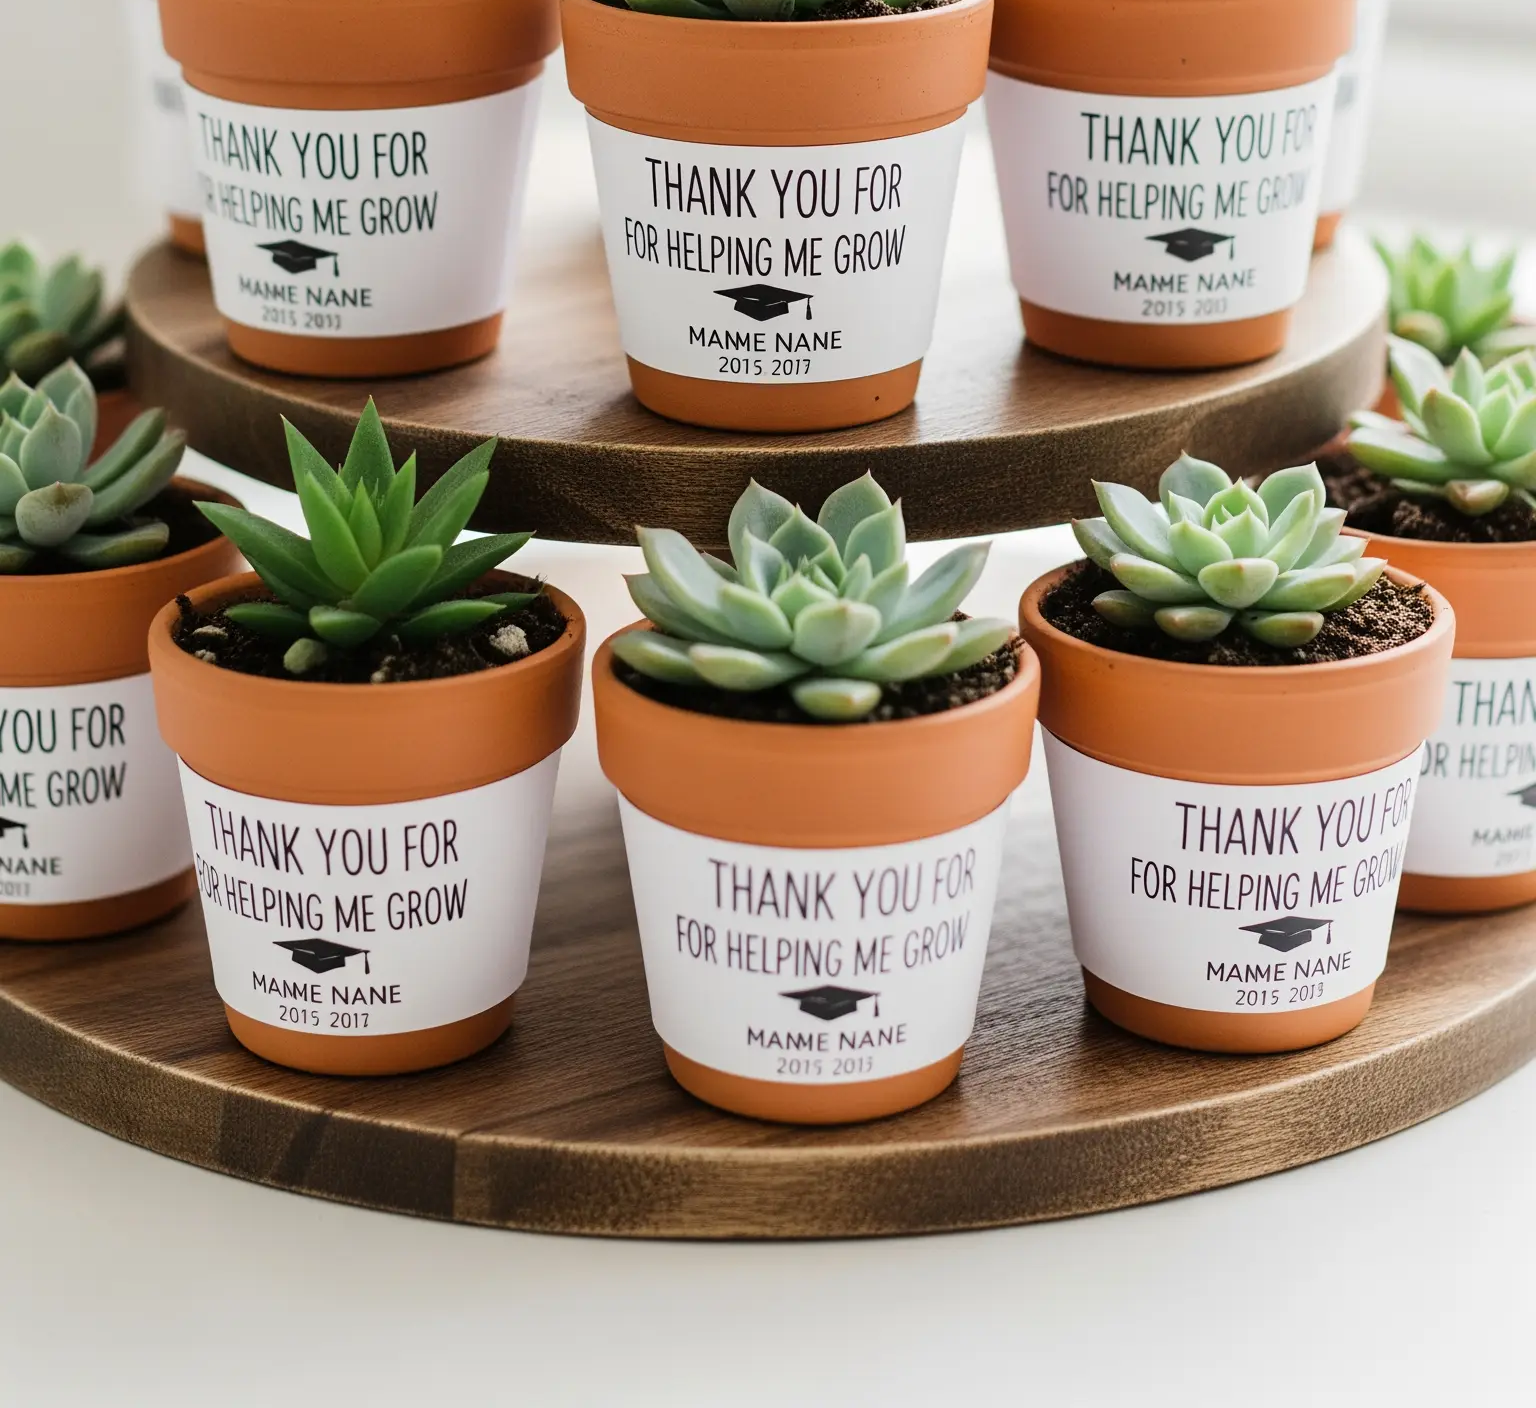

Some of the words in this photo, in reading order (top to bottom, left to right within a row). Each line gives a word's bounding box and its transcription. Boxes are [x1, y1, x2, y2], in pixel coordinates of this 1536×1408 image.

[199, 112, 281, 176] THANK
[291, 131, 359, 180] YOU
[374, 131, 428, 179] FOR
[1080, 112, 1200, 166] THANK
[1215, 112, 1275, 165] YOU
[218, 181, 303, 233] HELPING
[313, 198, 350, 235] ME
[361, 191, 438, 235] GROW
[645, 157, 757, 218] THANK
[770, 168, 841, 219] YOU
[853, 163, 902, 215] FOR
[1047, 171, 1089, 215] FOR
[1098, 180, 1204, 220] HELPING
[1214, 180, 1249, 220] ME
[624, 216, 659, 265] FOR
[667, 229, 772, 276] HELPING
[784, 237, 822, 277] ME
[834, 224, 907, 275] GROW
[306, 286, 373, 307] NANE
[1197, 269, 1256, 293] NANE
[1142, 300, 1185, 317] 2015
[719, 356, 762, 375] 2015
[775, 330, 842, 353] NANE
[71, 703, 126, 751] FOR
[47, 762, 126, 807] GROW
[204, 800, 304, 875] THANK
[315, 828, 387, 876] YOU
[404, 820, 458, 871] FOR
[1175, 801, 1302, 855] THANK
[1316, 793, 1376, 851] YOU
[1380, 778, 1411, 834] FOR
[196, 852, 222, 906] FOR
[224, 873, 323, 932] HELPING
[336, 895, 376, 932] ME
[387, 878, 468, 931] GROW
[708, 858, 837, 921] THANK
[852, 862, 923, 919] YOU
[932, 847, 976, 905] FOR
[1131, 856, 1176, 903] FOR
[1189, 870, 1299, 911] HELPING
[1309, 865, 1347, 908] ME
[1353, 840, 1404, 897] GROW
[676, 914, 718, 965] FOR
[727, 930, 842, 977] HELPING
[854, 934, 893, 976] ME
[904, 911, 971, 969] GROW
[1294, 951, 1352, 980] NANE
[279, 1005, 320, 1027] 2015
[332, 985, 401, 1005] NANE
[1236, 989, 1279, 1006] 2015
[839, 1023, 907, 1051] NANE
[777, 1057, 823, 1075] 2015
